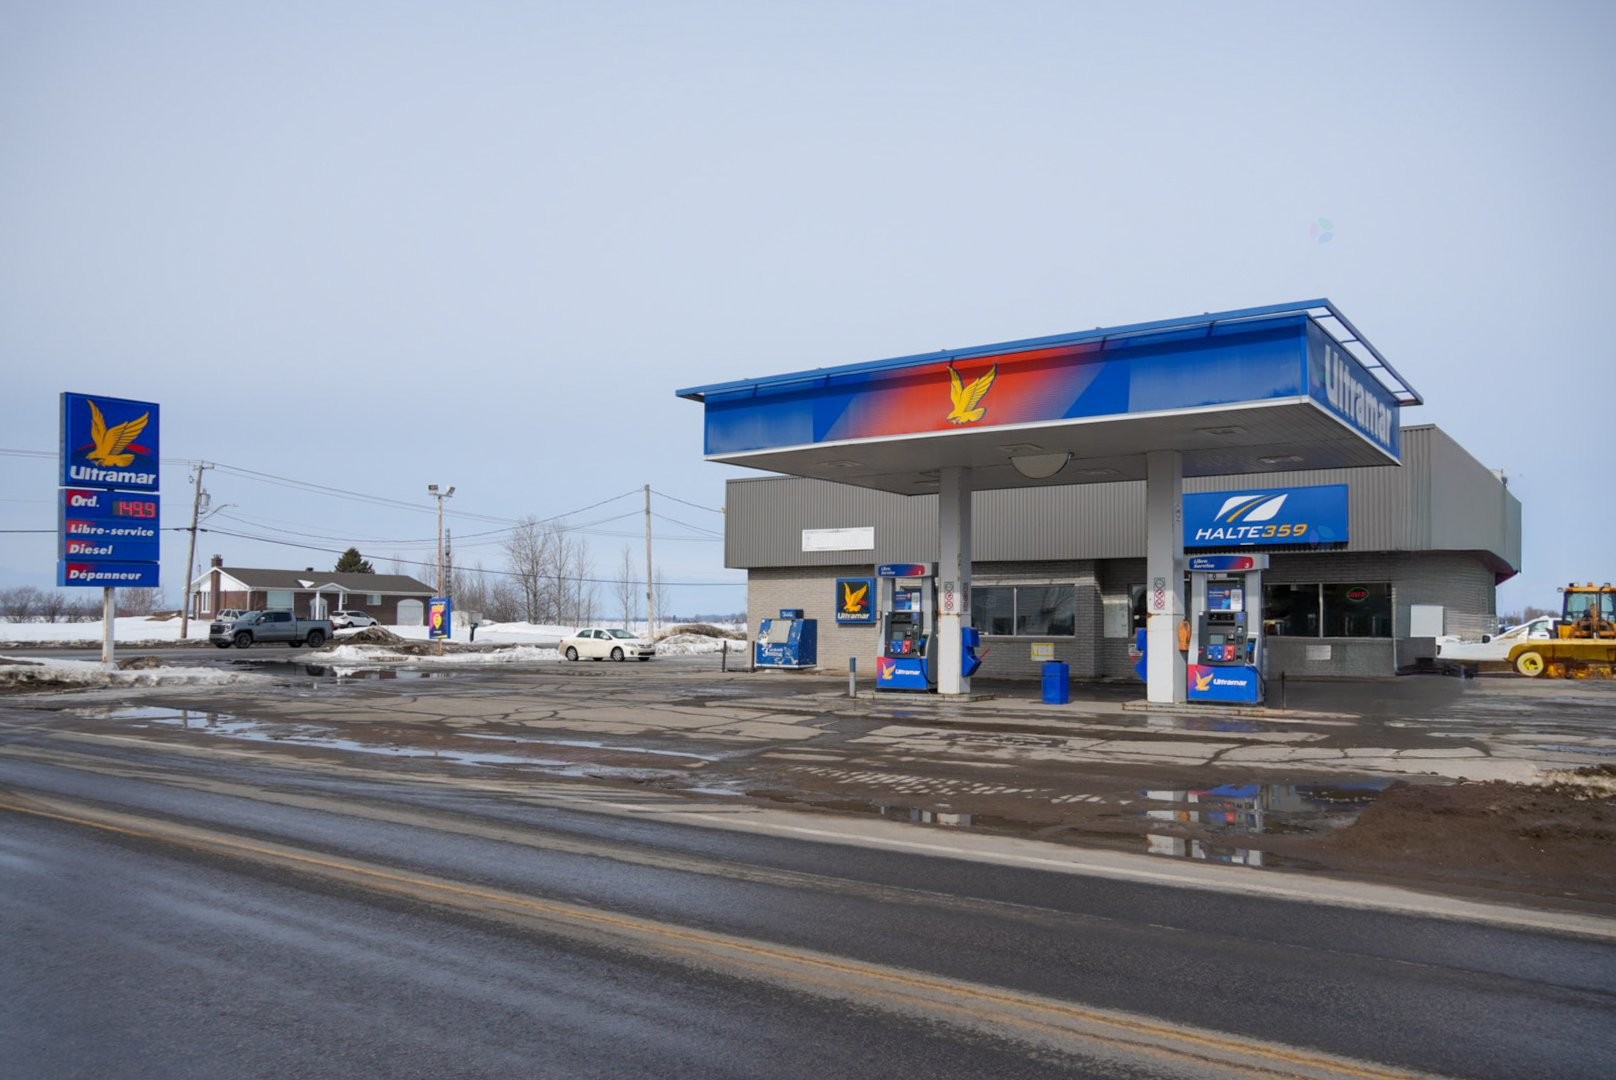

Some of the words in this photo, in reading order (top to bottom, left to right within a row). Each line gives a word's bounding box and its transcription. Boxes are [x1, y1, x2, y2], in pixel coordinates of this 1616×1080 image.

[1325, 345, 1391, 447] Ultramar
[70, 465, 156, 484] Ultramar
[71, 495, 99, 508] Ord.
[70, 524, 154, 537] Libre-service
[1195, 523, 1308, 540] HALTE359
[69, 544, 113, 555] Diesel
[69, 568, 141, 582] Dépanneur
[837, 612, 870, 620] Ultramar
[1213, 679, 1248, 687] Ultramar
